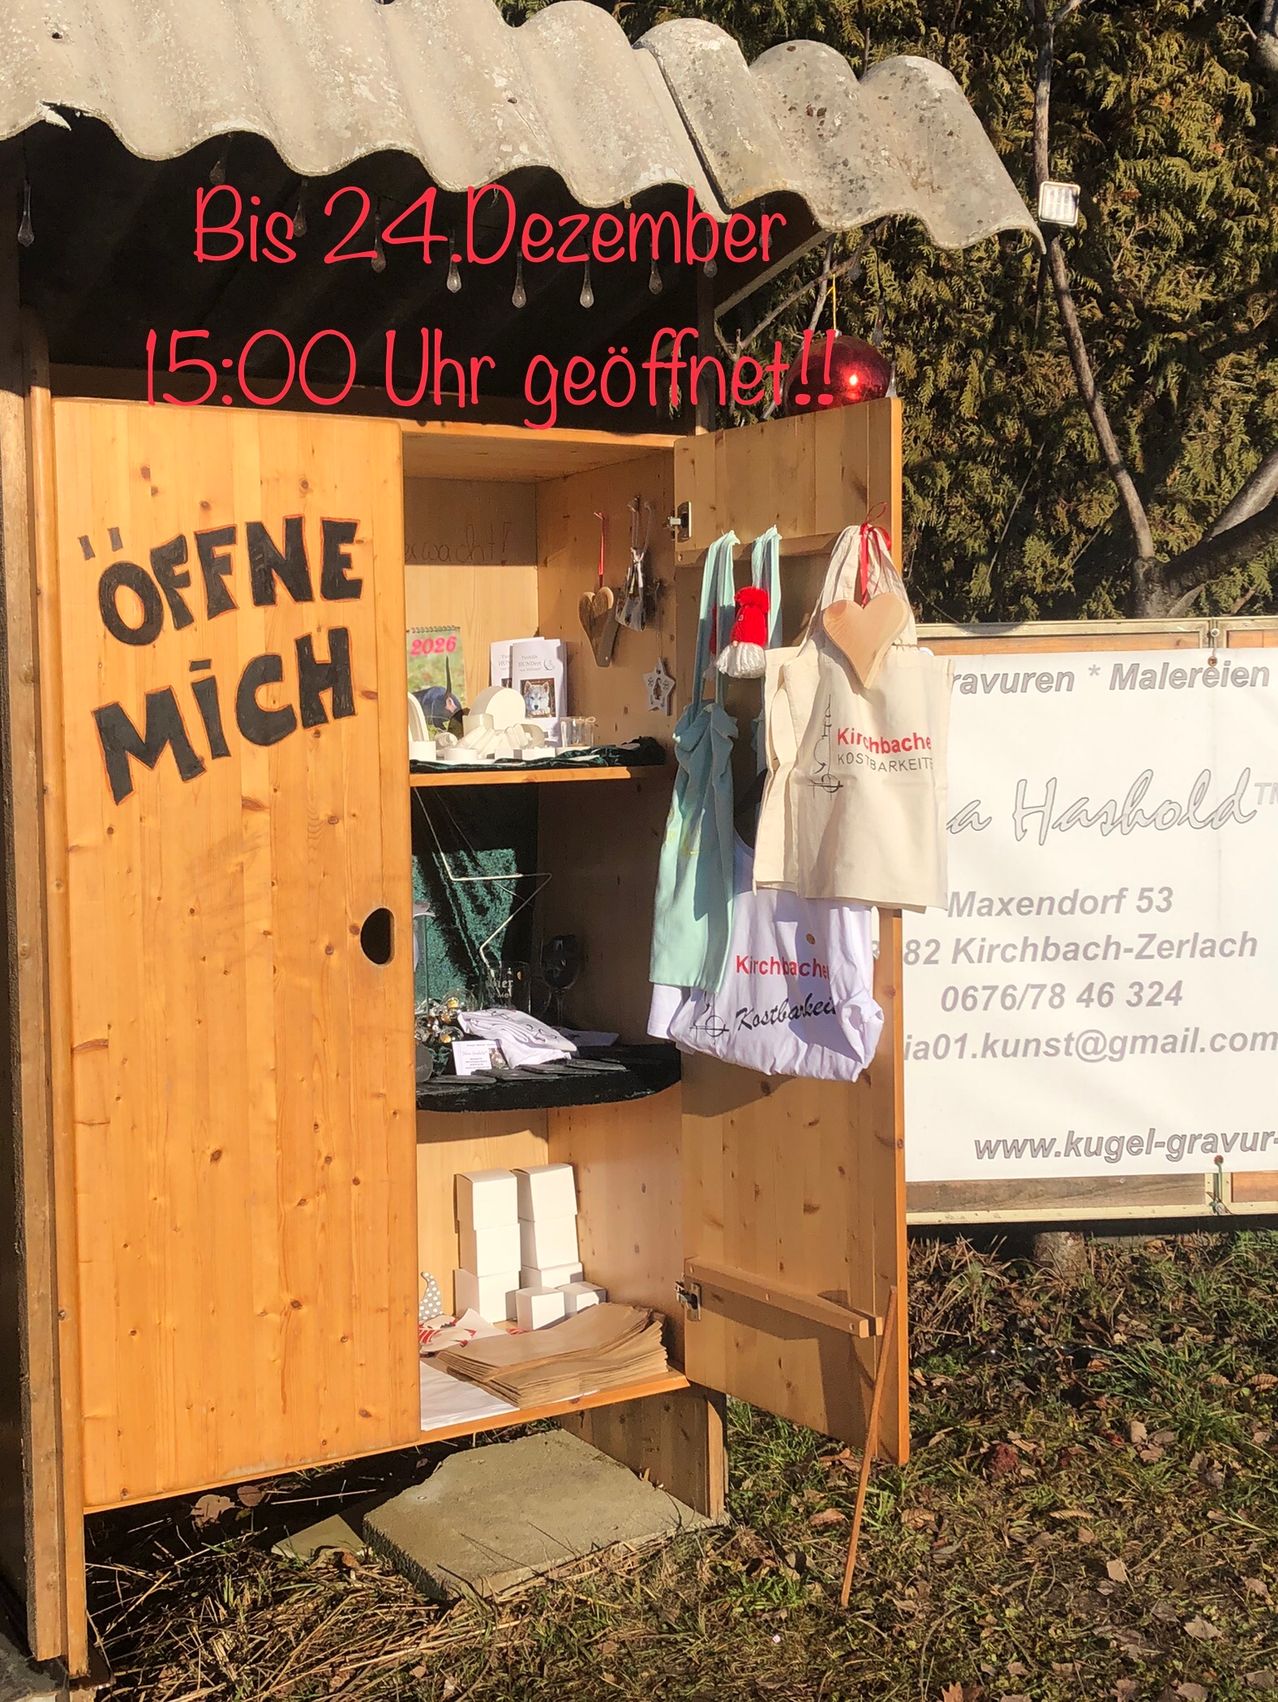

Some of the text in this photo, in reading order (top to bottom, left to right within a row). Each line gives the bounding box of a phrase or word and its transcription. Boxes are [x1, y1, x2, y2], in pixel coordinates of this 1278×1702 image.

[77, 514, 363, 647] ÖFFNE
[410, 635, 458, 657] 2026
[1109, 660, 1271, 692] Malereien
[948, 886, 1174, 918] Maxendorf 53
[903, 930, 1258, 966] 82 Kirchbach-Zerlach
[940, 980, 1184, 1012] 0676/78 46 324
